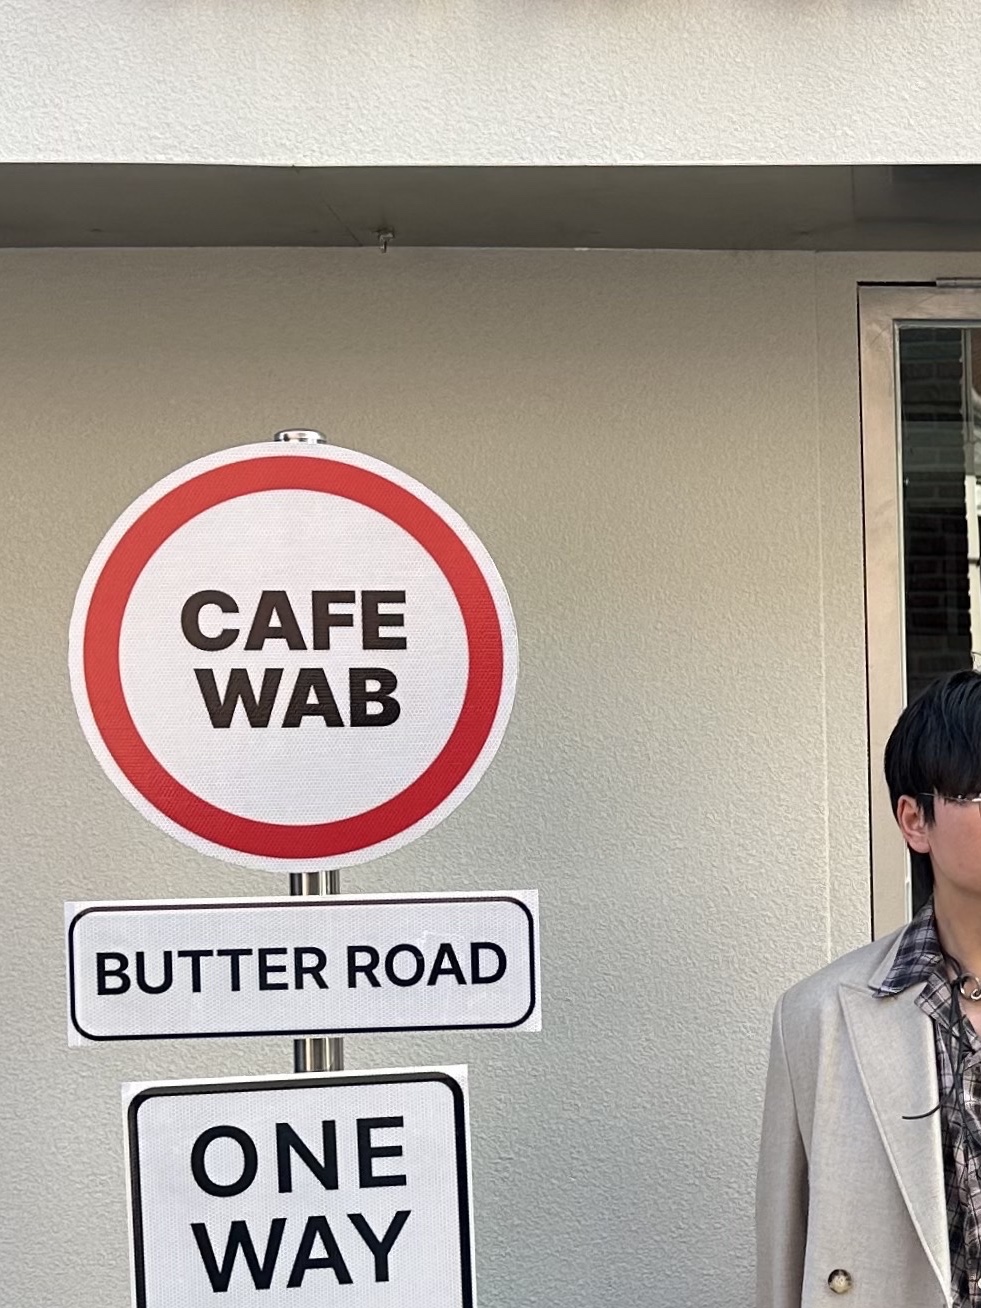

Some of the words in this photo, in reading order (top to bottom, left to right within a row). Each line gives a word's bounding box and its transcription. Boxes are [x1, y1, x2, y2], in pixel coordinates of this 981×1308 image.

[181, 590, 408, 652] CAFE
[193, 667, 401, 729] WAB
[95, 946, 329, 996] BUTTER
[346, 941, 507, 989] ROAD
[190, 1115, 407, 1198] ONE
[190, 1210, 412, 1294] WAY
